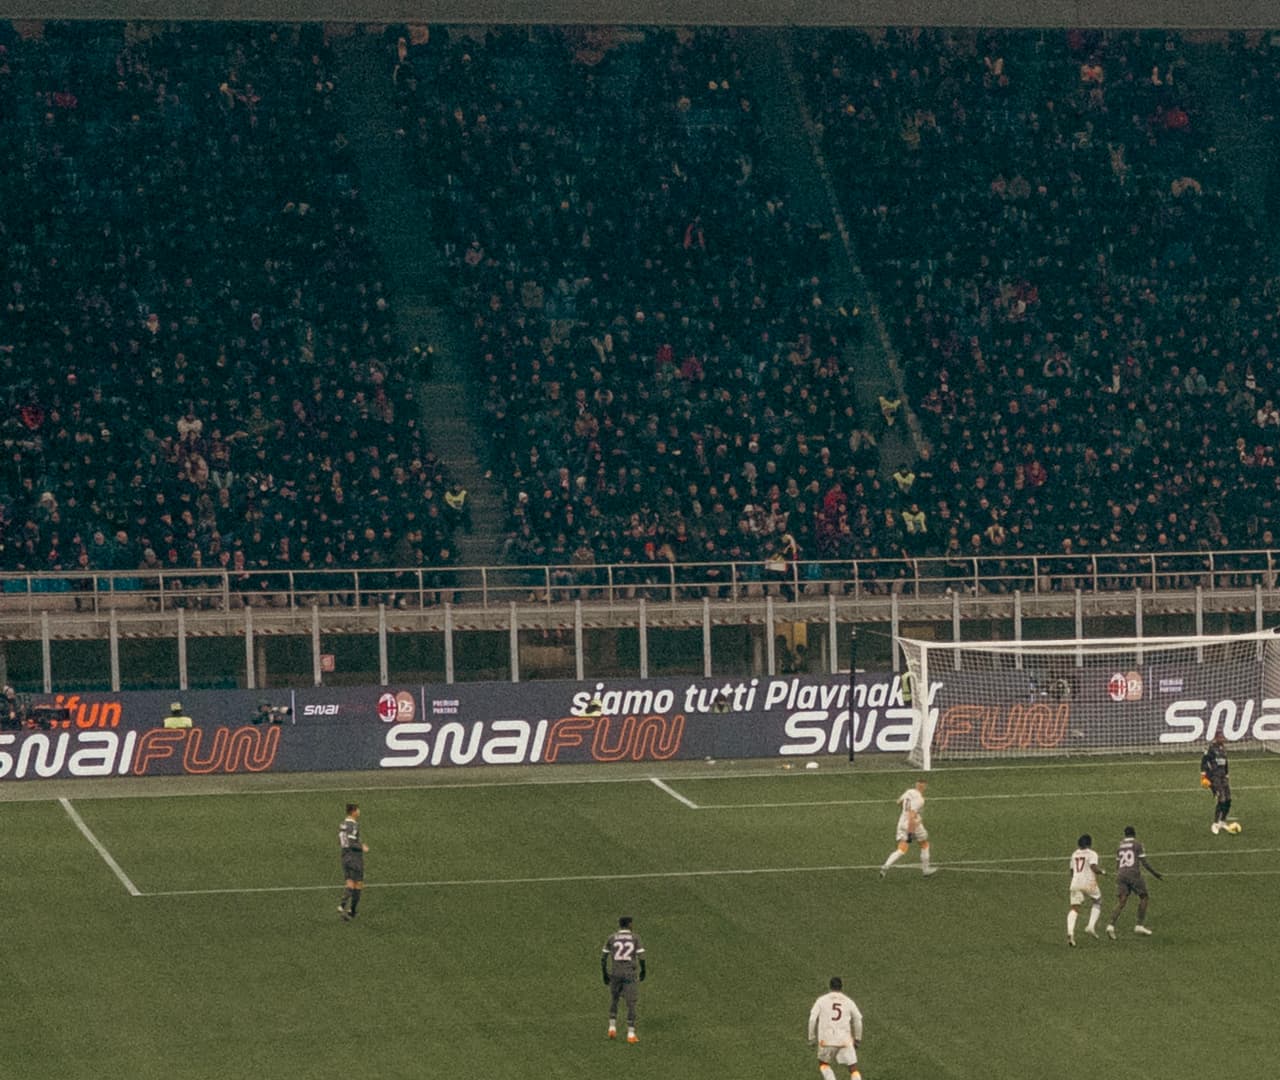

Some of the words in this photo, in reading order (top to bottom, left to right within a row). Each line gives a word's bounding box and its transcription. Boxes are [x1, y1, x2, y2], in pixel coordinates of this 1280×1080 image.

[764, 675, 943, 711] Playmakr
[1074, 857, 1086, 873] 17
[613, 941, 635, 961] 22
[831, 1003, 843, 1021] 5
